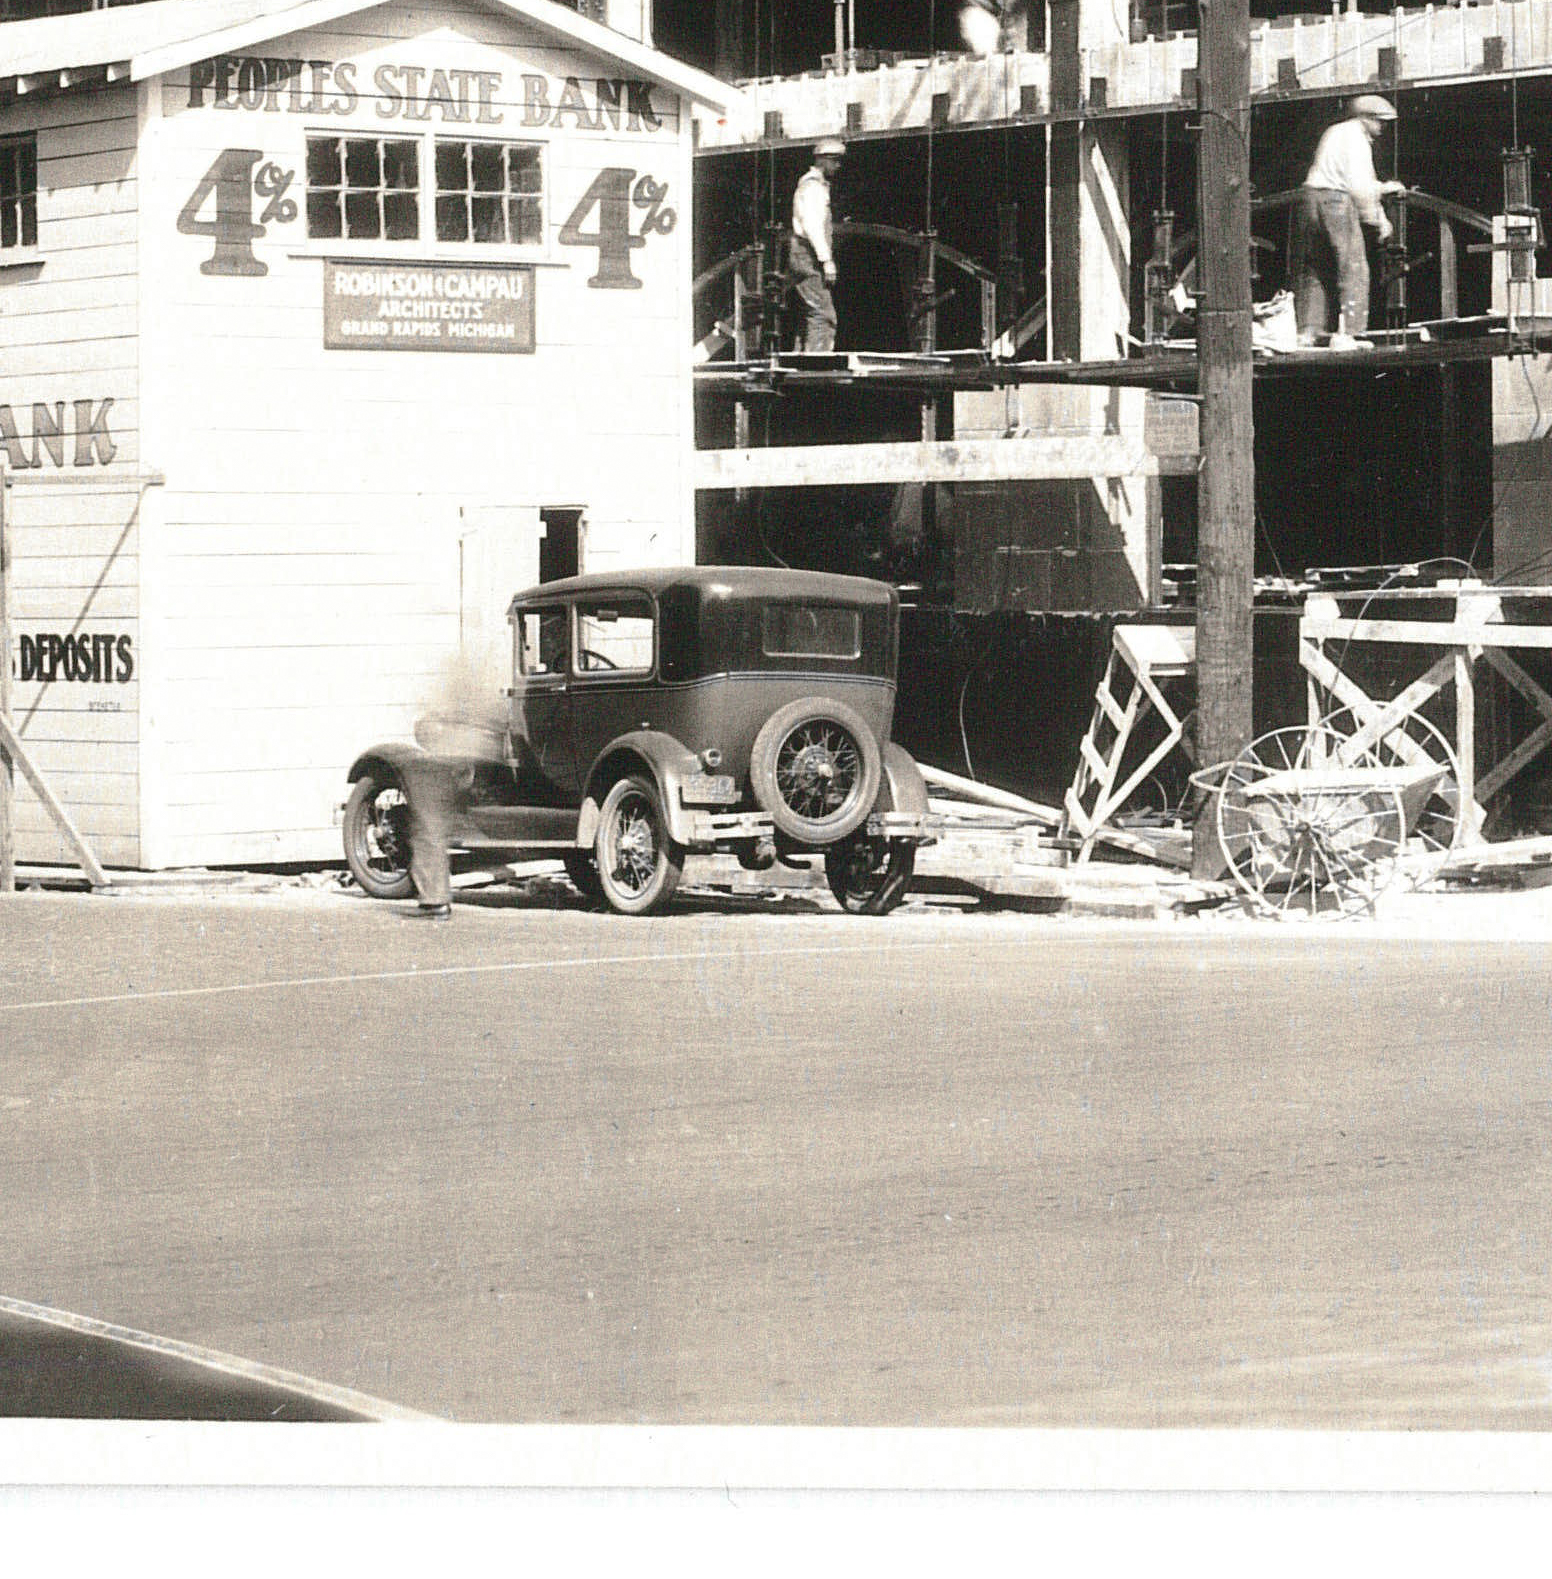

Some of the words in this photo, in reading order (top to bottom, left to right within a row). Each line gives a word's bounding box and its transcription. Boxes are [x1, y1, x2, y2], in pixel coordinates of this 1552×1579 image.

[188, 56, 357, 116] PEOPLES
[374, 65, 504, 126] STATE
[521, 73, 664, 134] BANK
[176, 147, 298, 277] 4%
[558, 167, 678, 290] 4%
[378, 300, 484, 320] ARCHITECTS
[445, 274, 524, 300] CAMPAU
[340, 320, 388, 337] GRAND
[392, 321, 442, 337] RAPIDS
[448, 322, 516, 338] MICHIGAN
[20, 633, 134, 684] DEPOSITS
